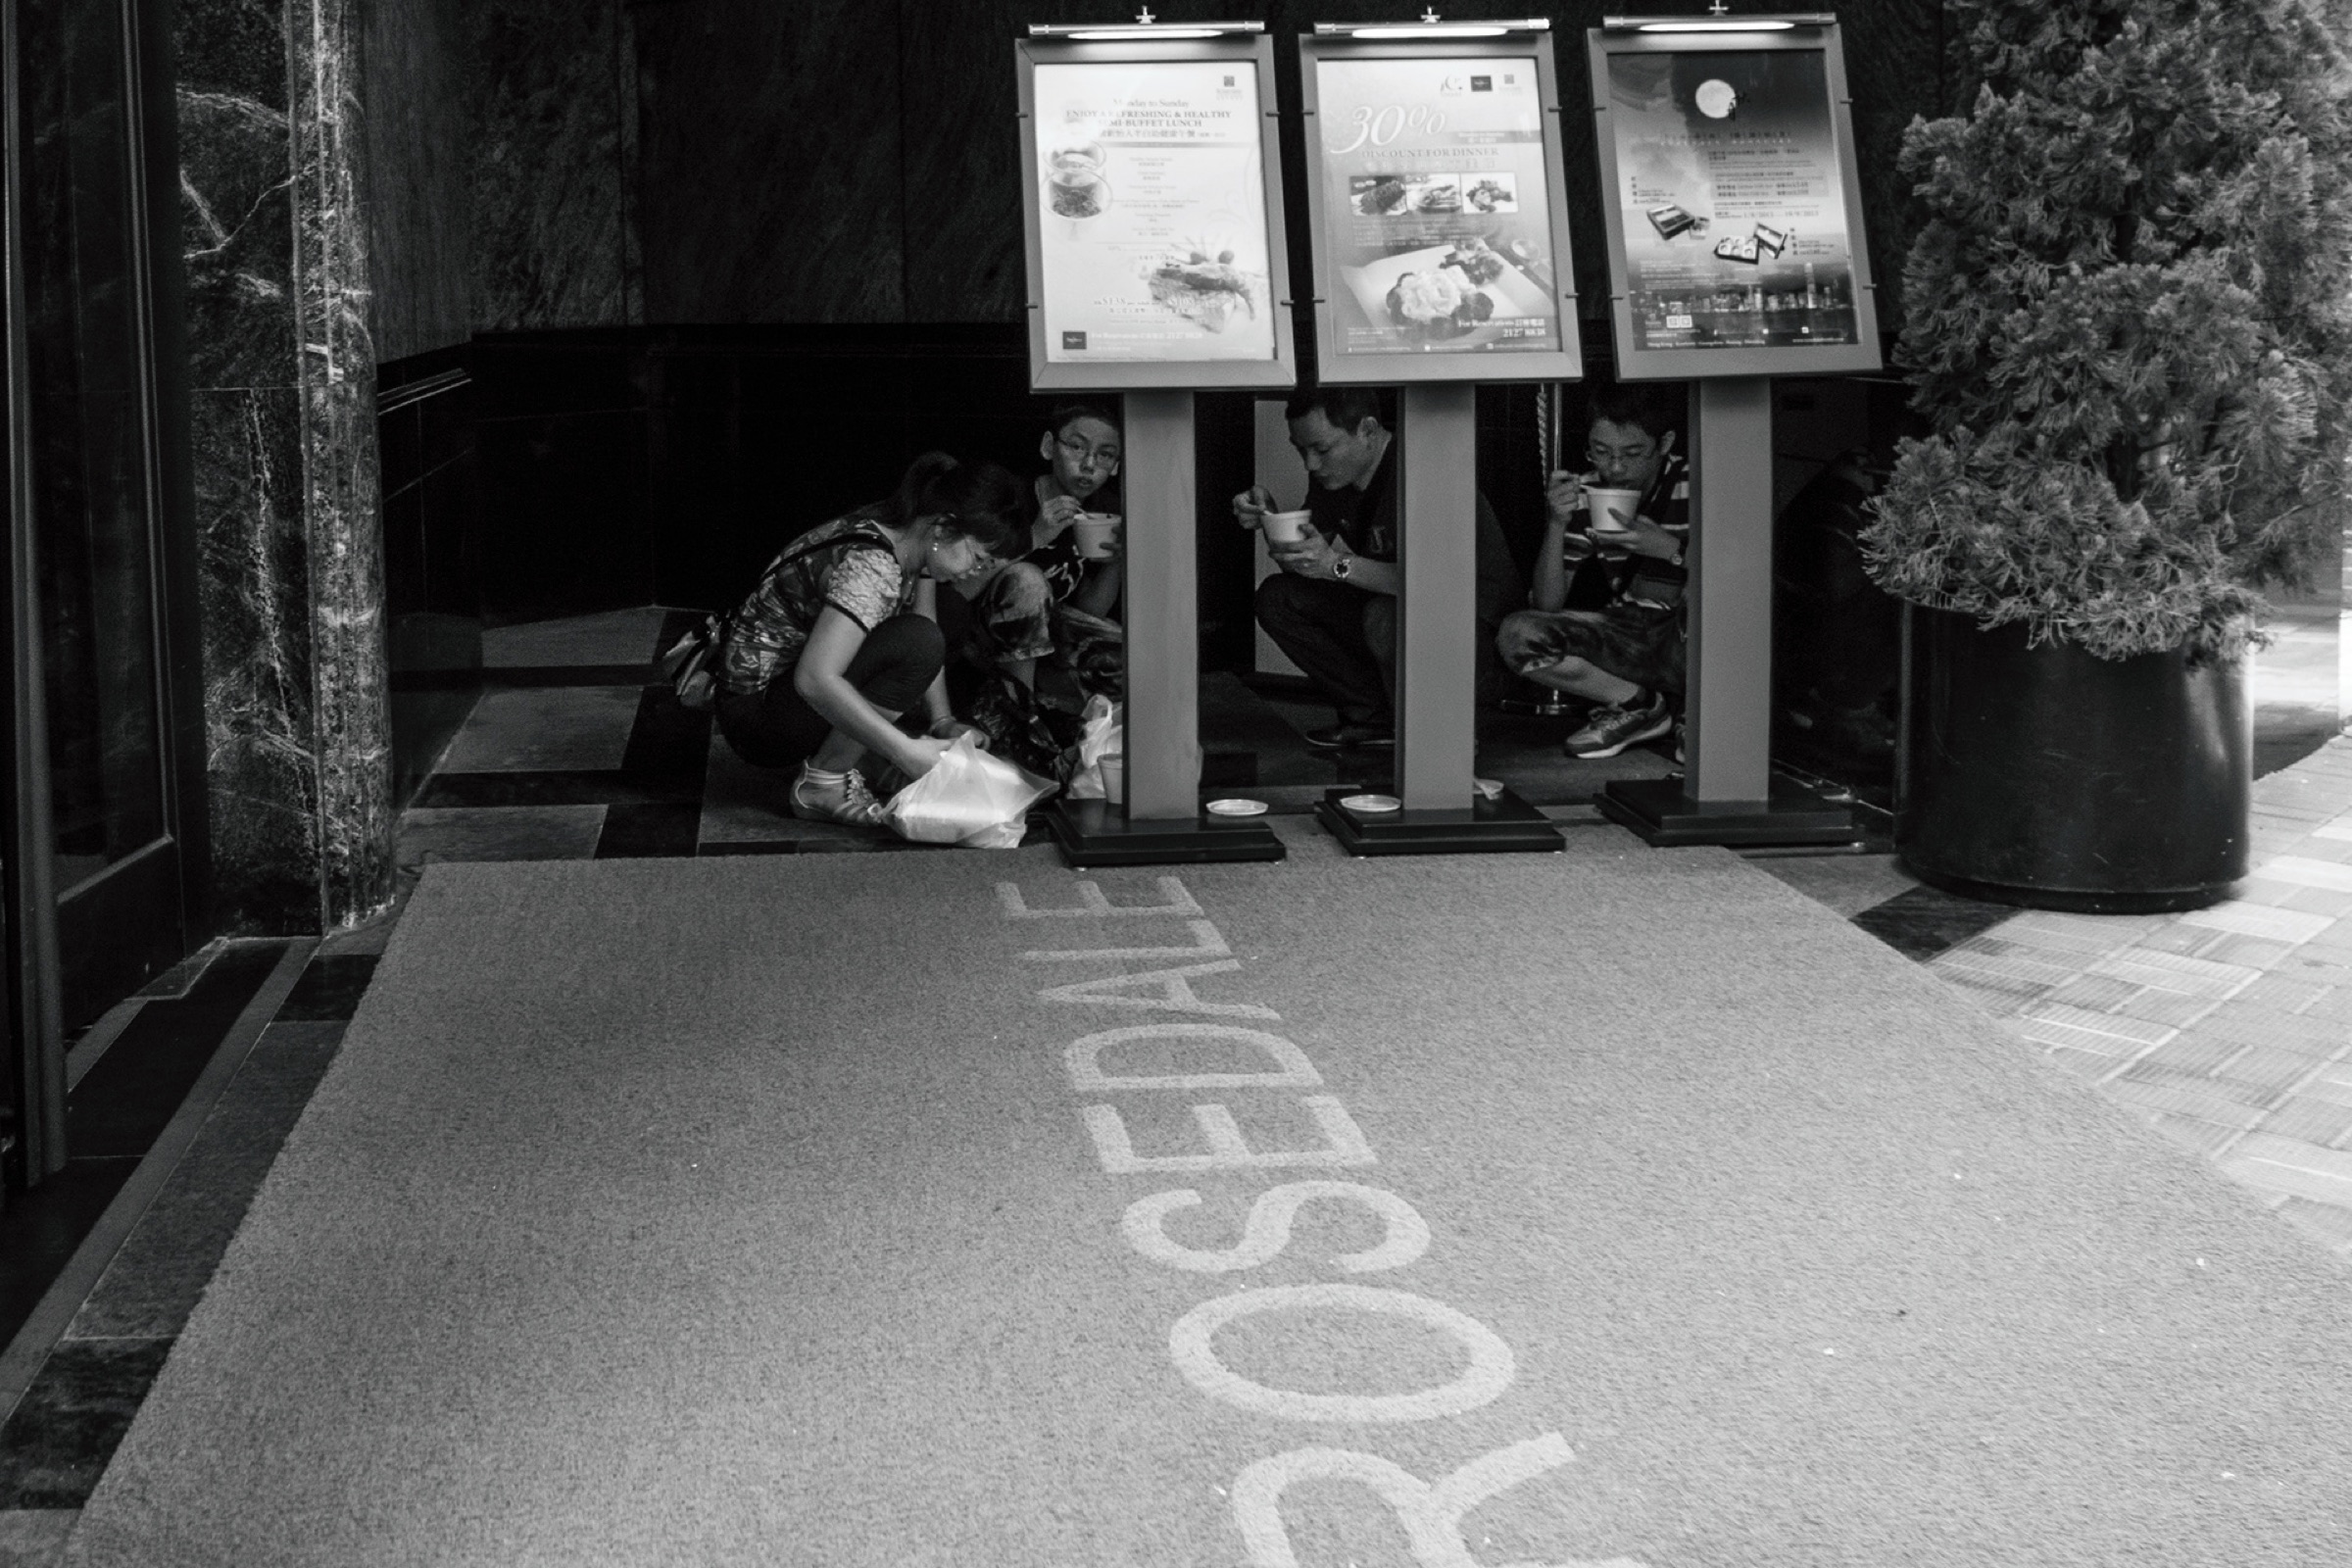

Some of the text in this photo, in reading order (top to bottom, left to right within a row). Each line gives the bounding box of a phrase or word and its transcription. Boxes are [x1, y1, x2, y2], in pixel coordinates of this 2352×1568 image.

[1159, 99, 1190, 109] Sunday
[1065, 110, 1099, 119] ENJOY
[1184, 110, 1232, 119] HEALTHY
[1166, 119, 1202, 127] LUNCH
[1330, 104, 1446, 154] 30%
[1361, 147, 1499, 158] DISCOUNT FOR DINNER
[994, 875, 1652, 1568] ROSEDALE
